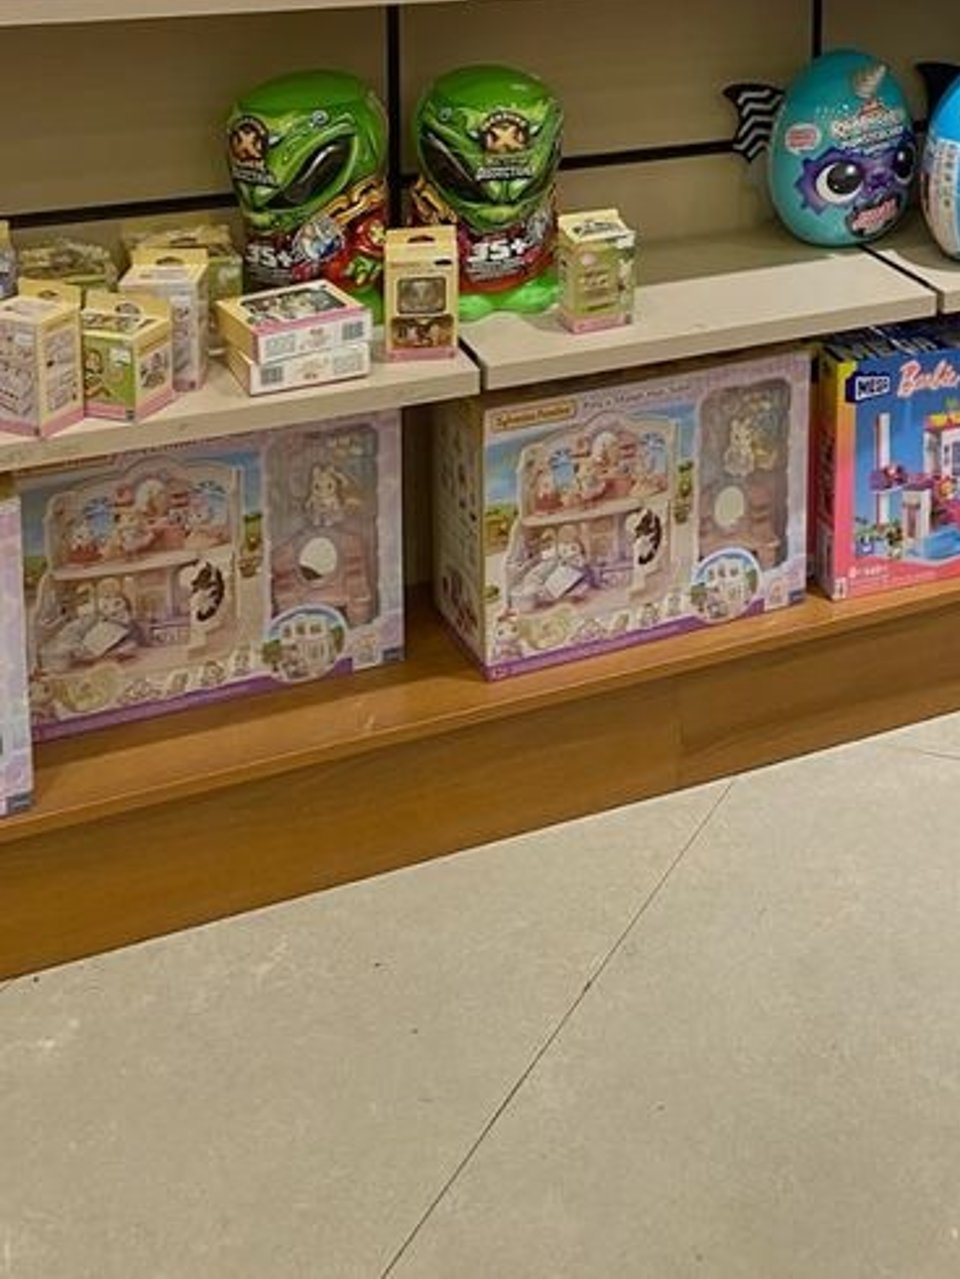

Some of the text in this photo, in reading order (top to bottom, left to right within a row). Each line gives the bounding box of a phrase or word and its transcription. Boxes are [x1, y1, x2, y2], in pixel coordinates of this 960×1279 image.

[245, 241, 293, 268] 35+
[467, 238, 527, 264] 35+
[897, 360, 960, 398] Barbie
